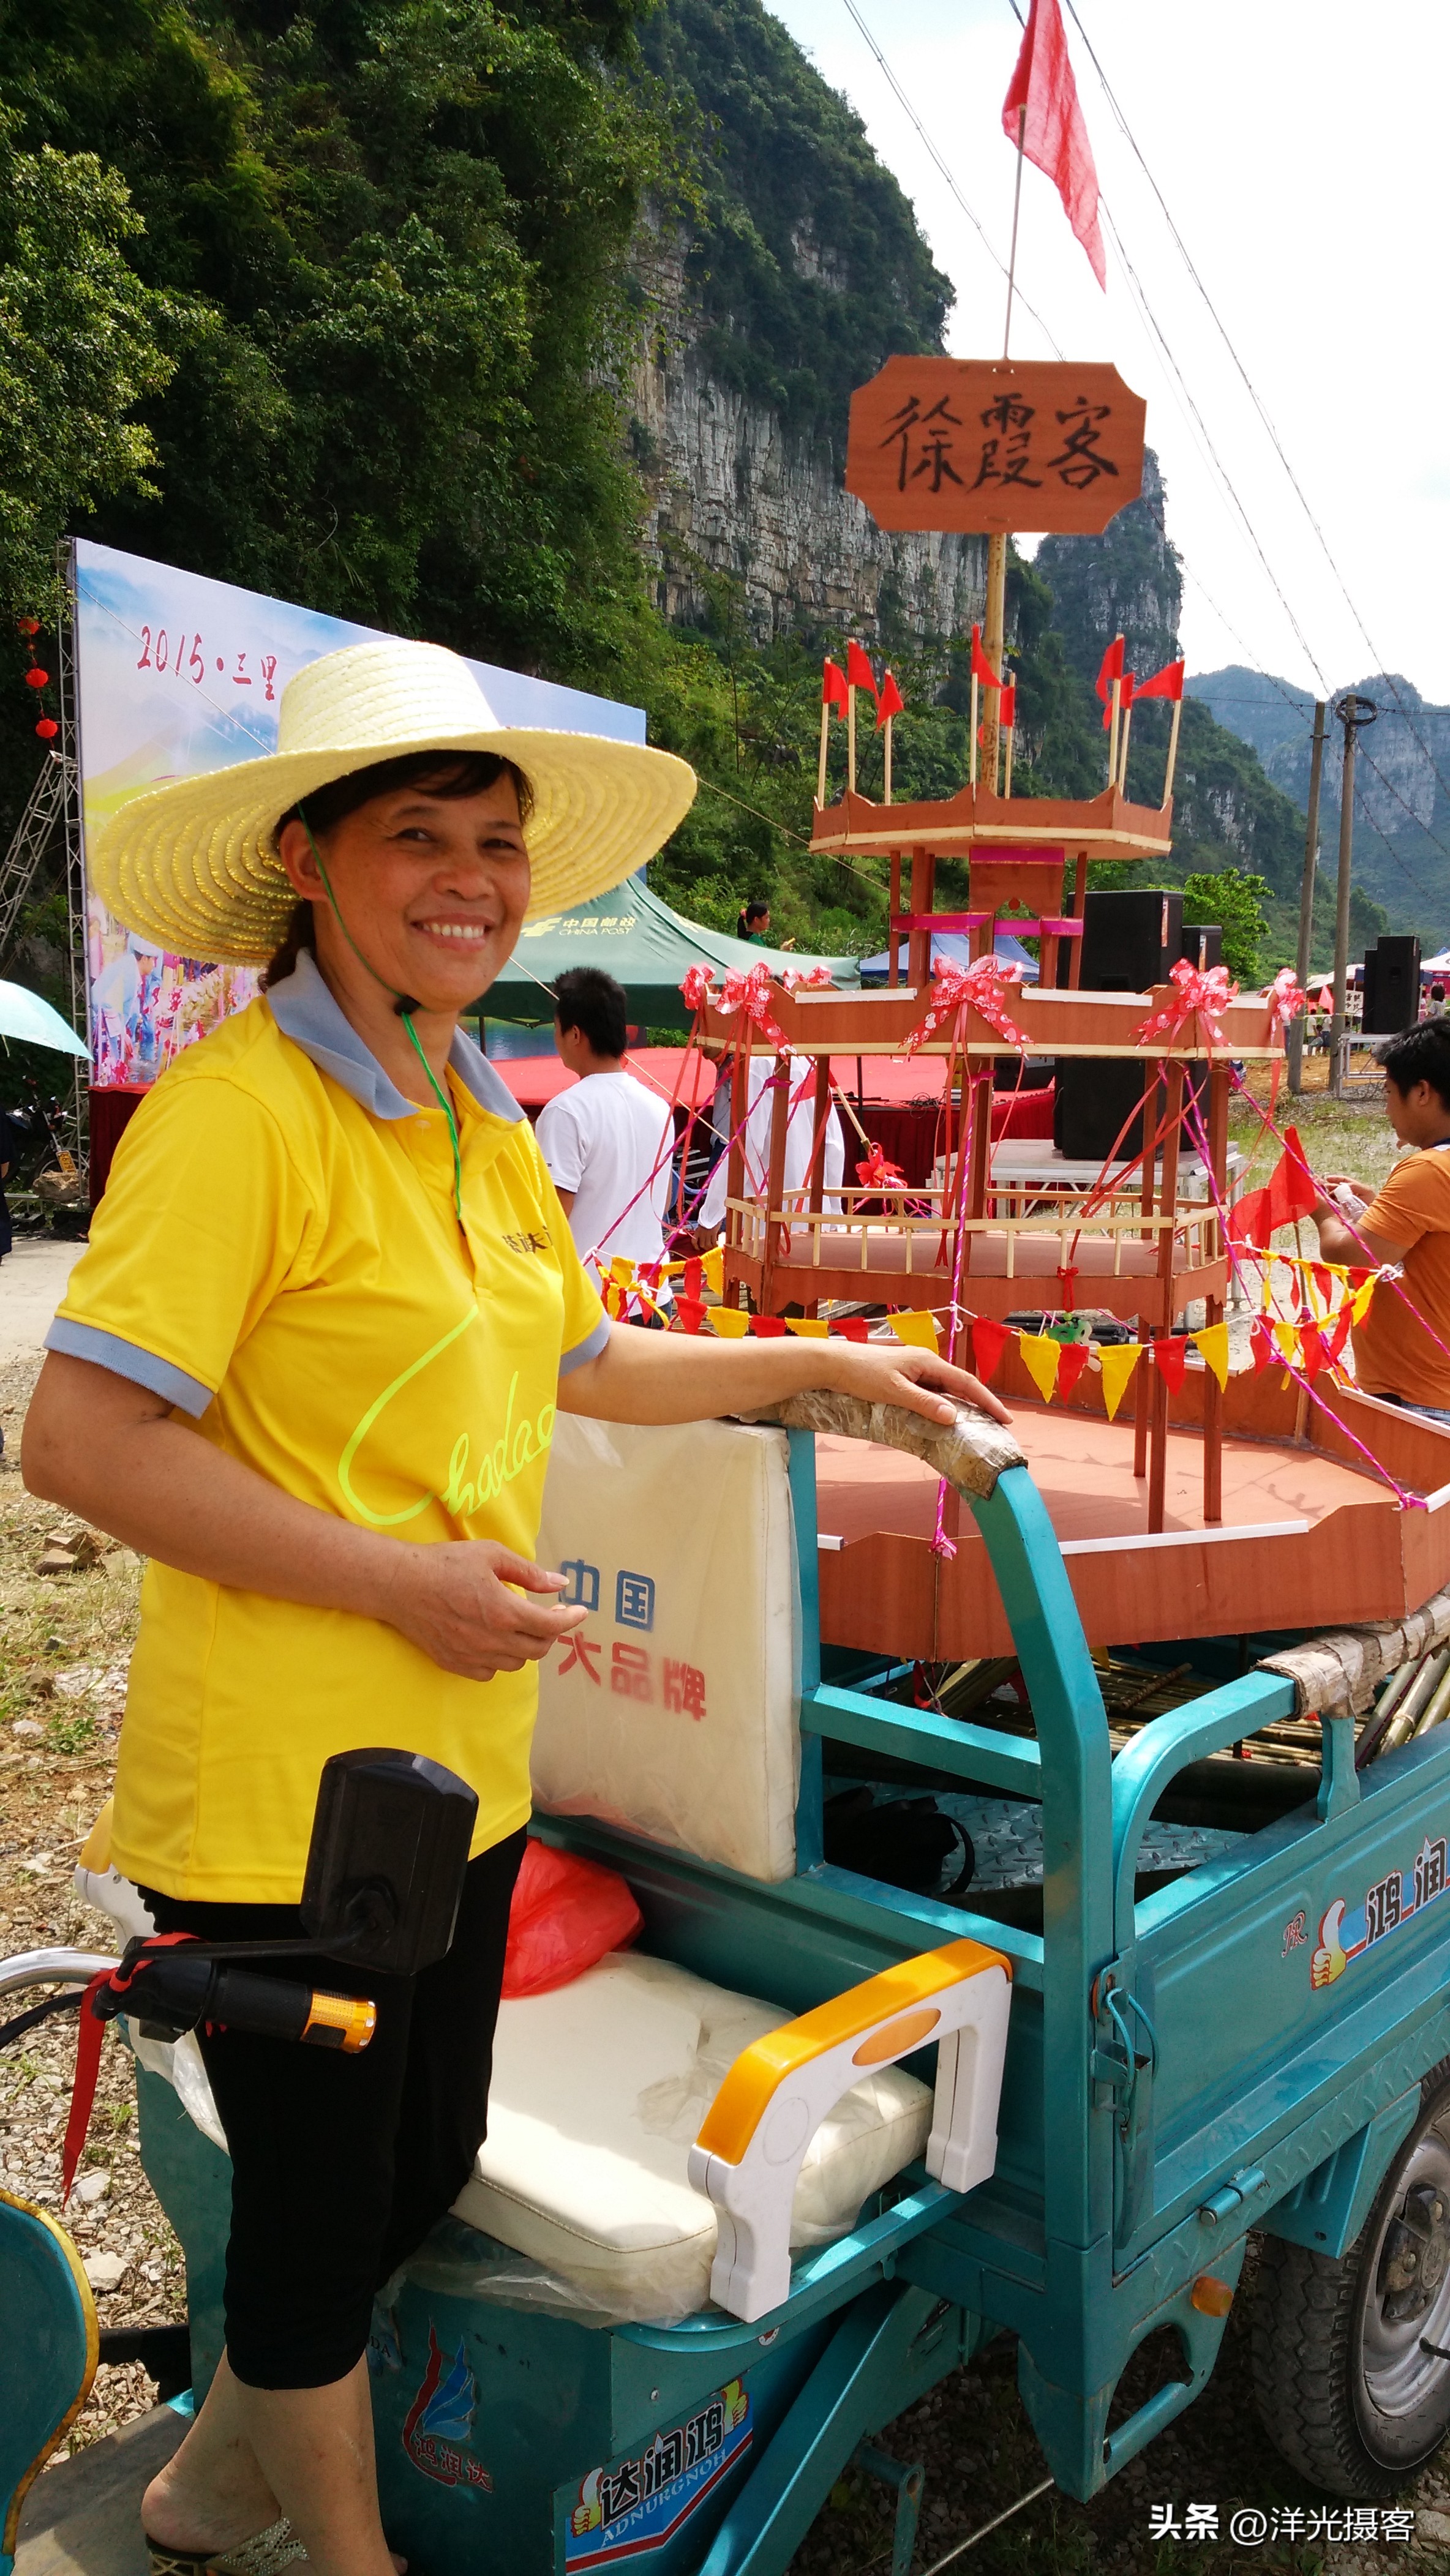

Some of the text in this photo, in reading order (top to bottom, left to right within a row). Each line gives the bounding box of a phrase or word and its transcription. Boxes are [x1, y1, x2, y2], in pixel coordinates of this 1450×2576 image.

[878, 392, 1119, 493] 徐霞客
[563, 917, 636, 927] 中国邮政
[558, 1559, 656, 1633] 中国
[557, 1631, 707, 1722] 大品牌
[1365, 1836, 1447, 1945] 鸿润
[415, 2433, 492, 2493] 鸿润达
[601, 2448, 727, 2548] ADNURGNOH
